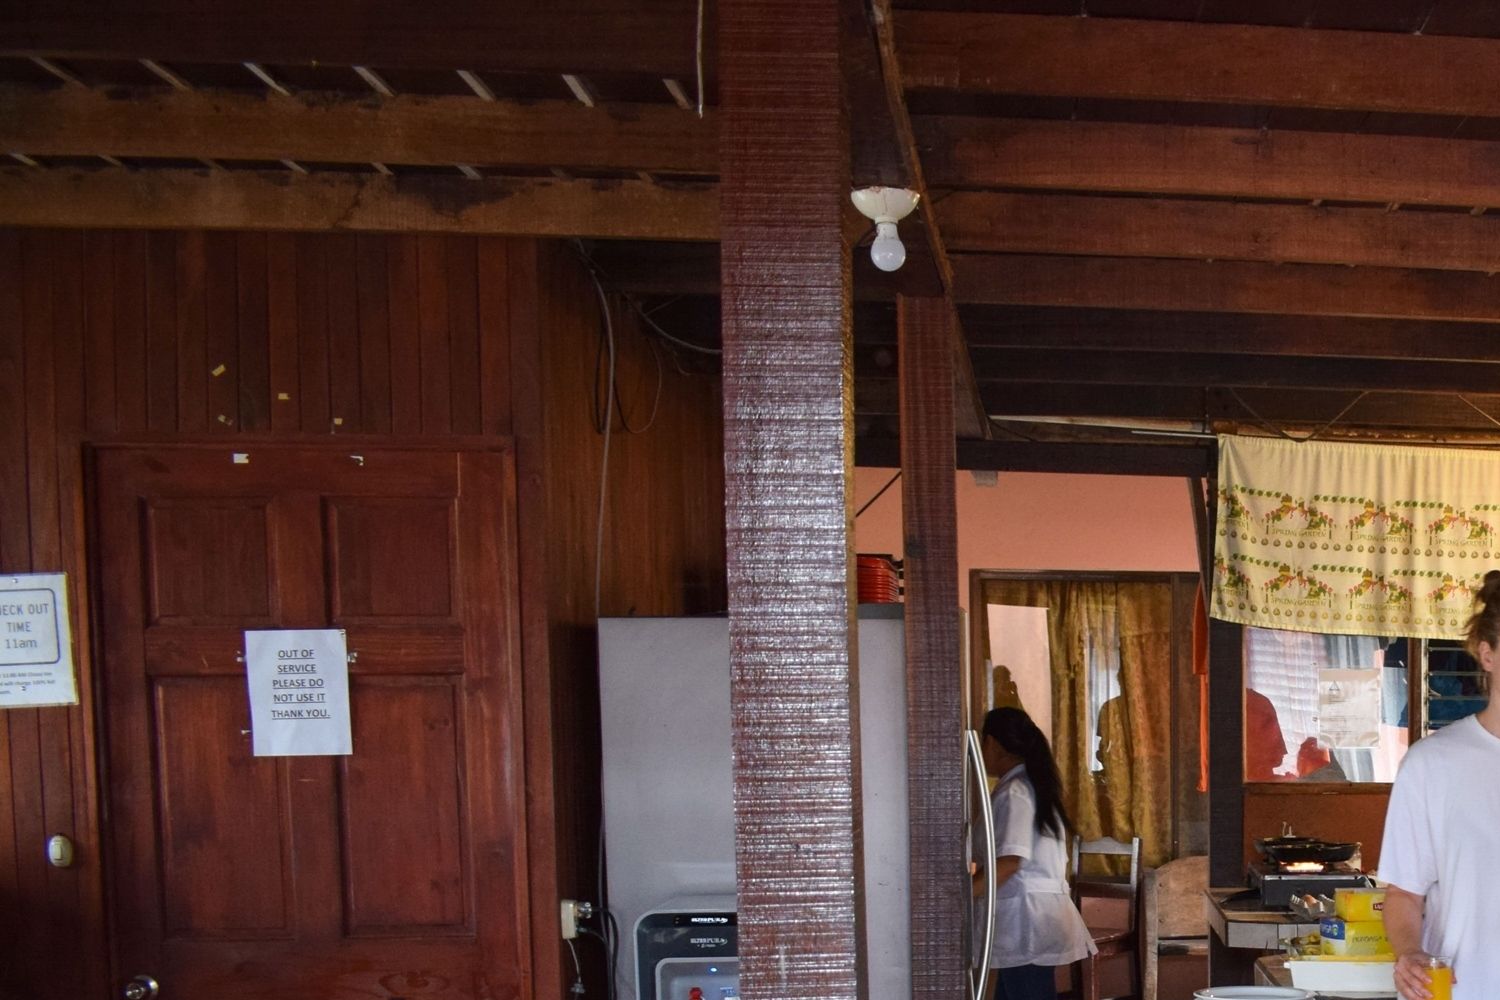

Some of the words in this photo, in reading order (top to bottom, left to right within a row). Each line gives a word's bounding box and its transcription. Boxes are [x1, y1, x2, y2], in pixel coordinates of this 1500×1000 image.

[28, 603, 49, 615] OUT
[7, 621, 31, 632] TIME
[6, 638, 37, 649] 11am
[278, 650, 298, 658] OUT
[301, 650, 314, 658] OF
[277, 664, 317, 673] SERVICE
[272, 679, 306, 688] PLEASE
[309, 679, 324, 687] DO
[273, 694, 294, 702] NOT
[296, 693, 314, 702] USE
[317, 693, 326, 701] IT
[271, 709, 303, 718] THANK
[305, 709, 330, 718] YOU.
